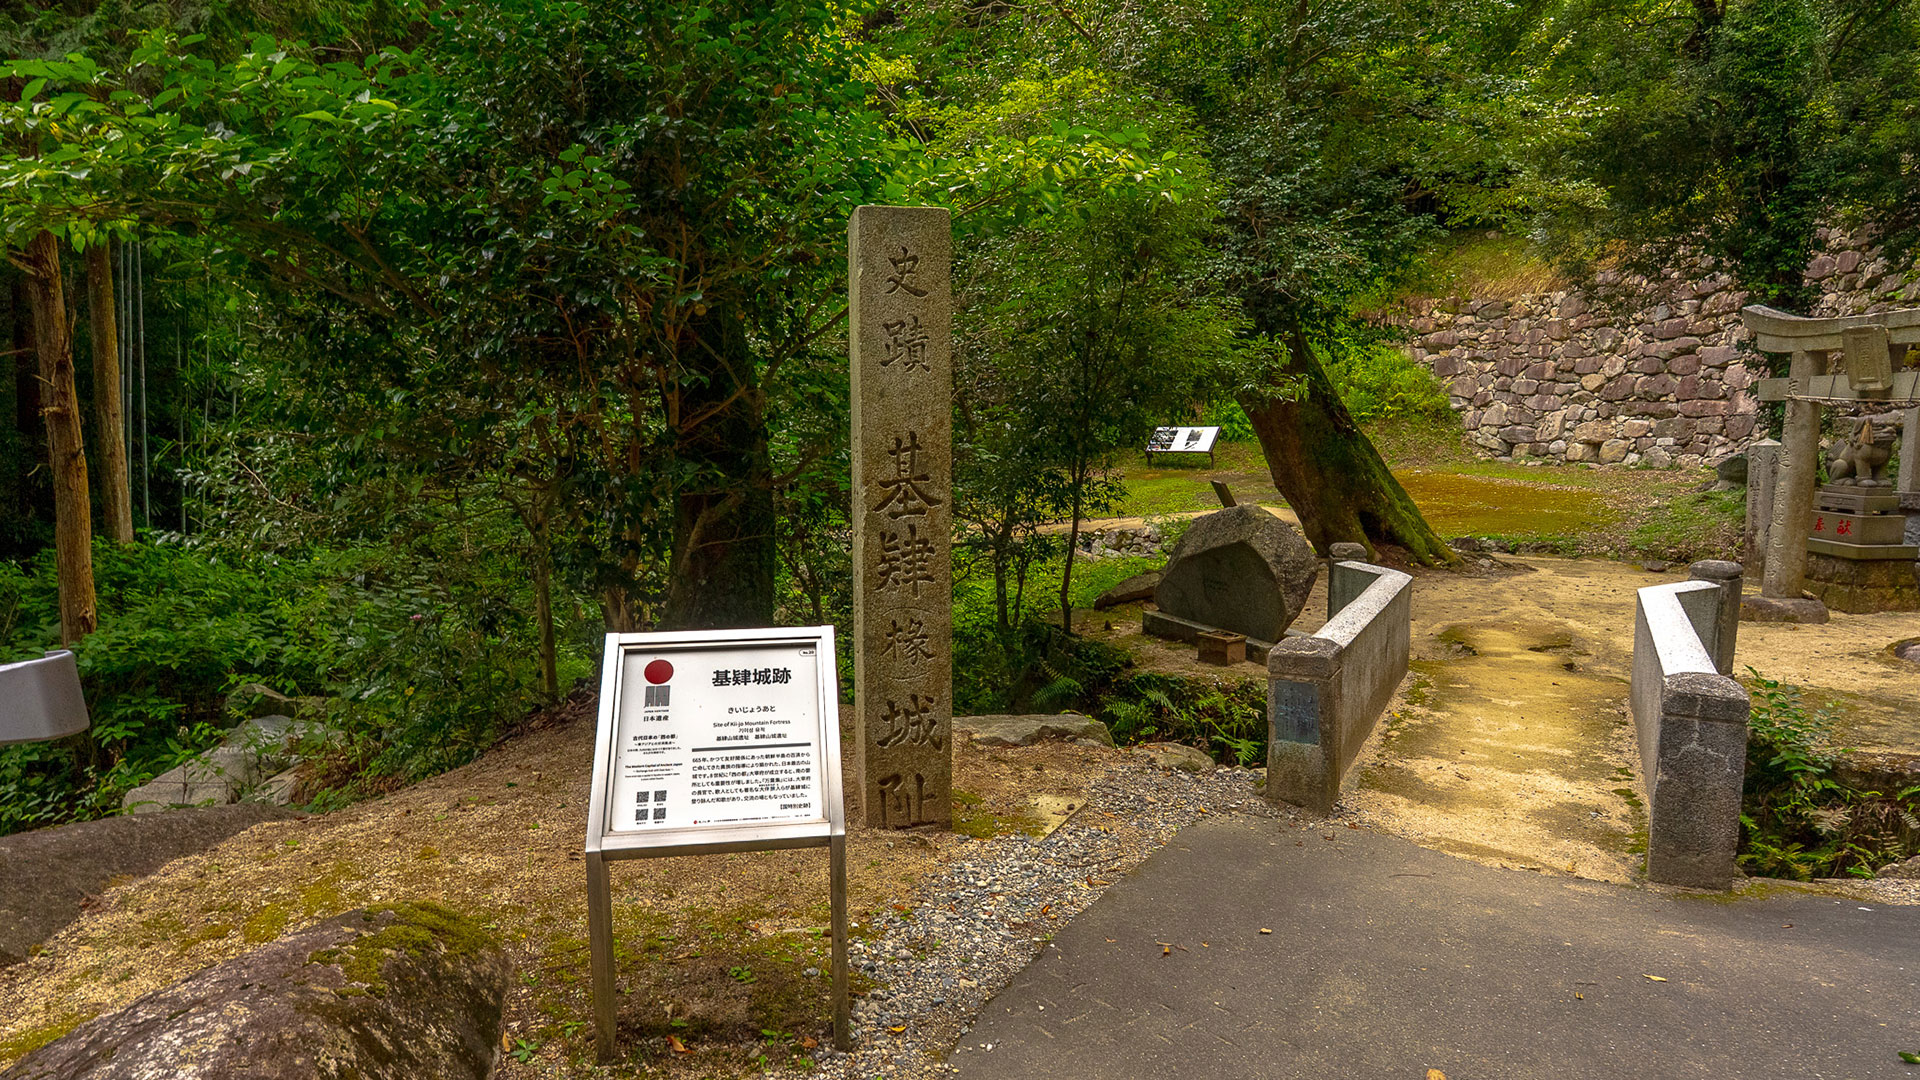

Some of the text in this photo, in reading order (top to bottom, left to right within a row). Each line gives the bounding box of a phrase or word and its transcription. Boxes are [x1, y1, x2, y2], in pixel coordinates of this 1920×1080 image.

[712, 667, 792, 687] 基肄城跡
[727, 705, 776, 714] きいじょうあと
